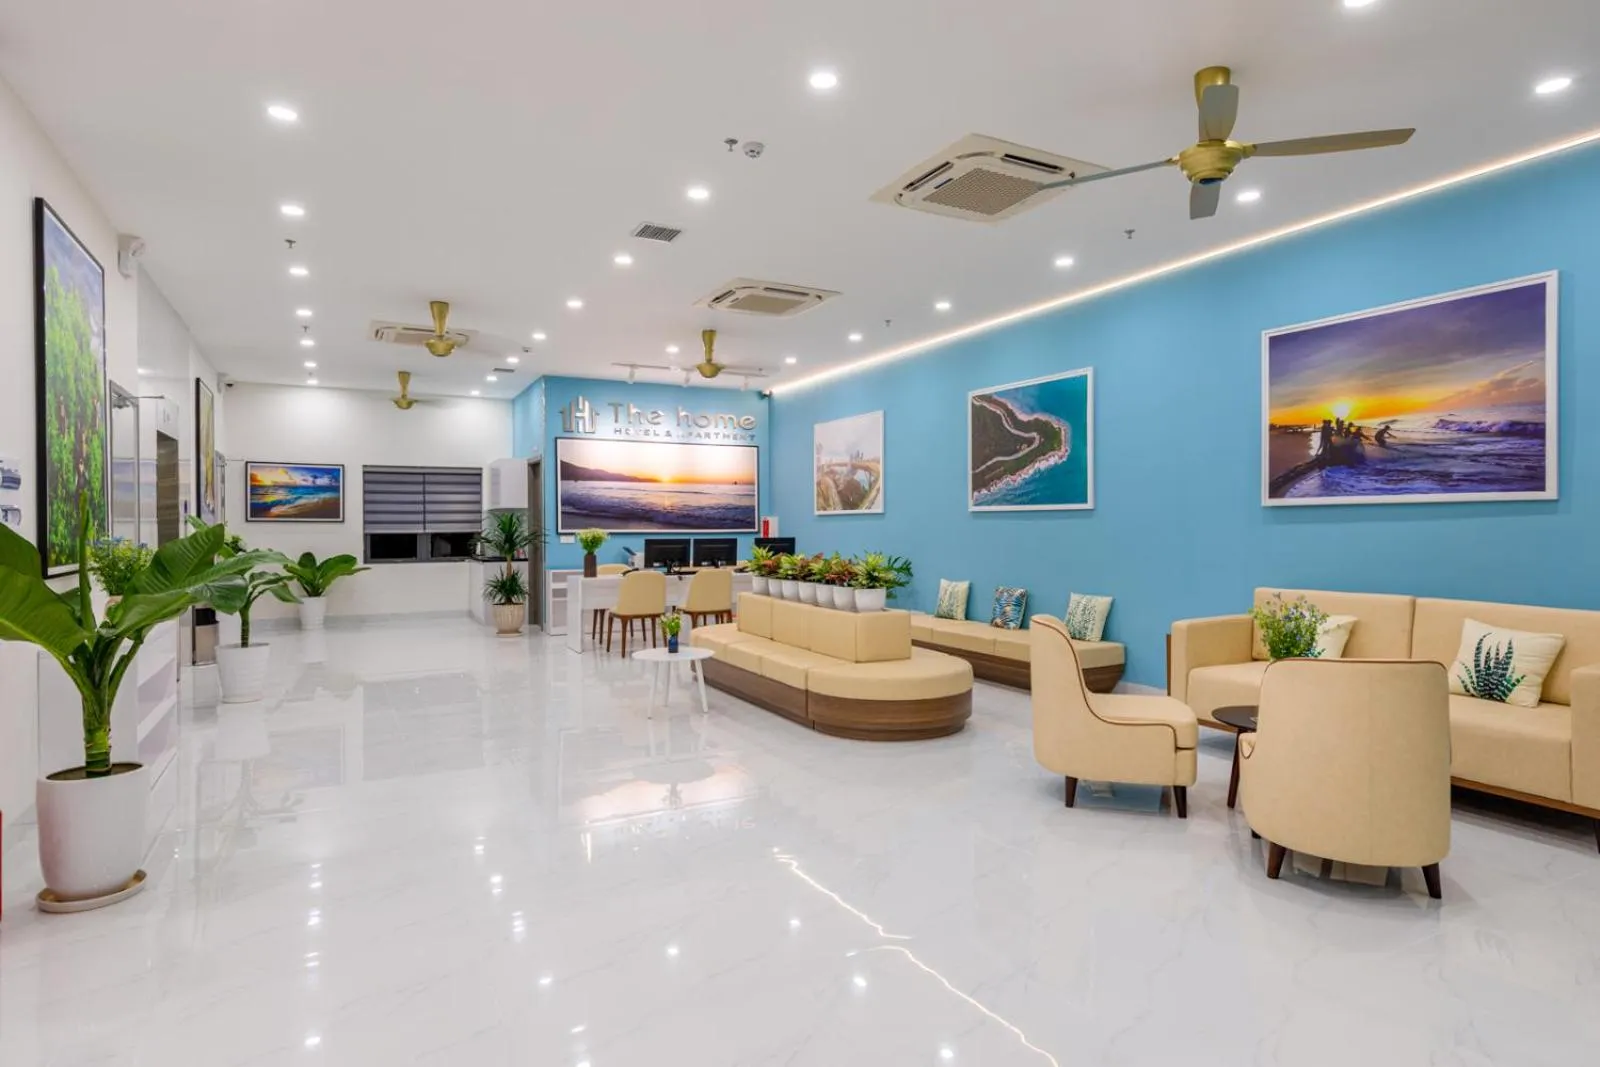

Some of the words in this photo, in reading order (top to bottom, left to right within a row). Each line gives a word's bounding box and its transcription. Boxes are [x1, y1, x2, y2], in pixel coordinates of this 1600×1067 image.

[608, 402, 664, 425] The
[676, 406, 756, 430] home
[676, 432, 755, 442] PARTMENT
